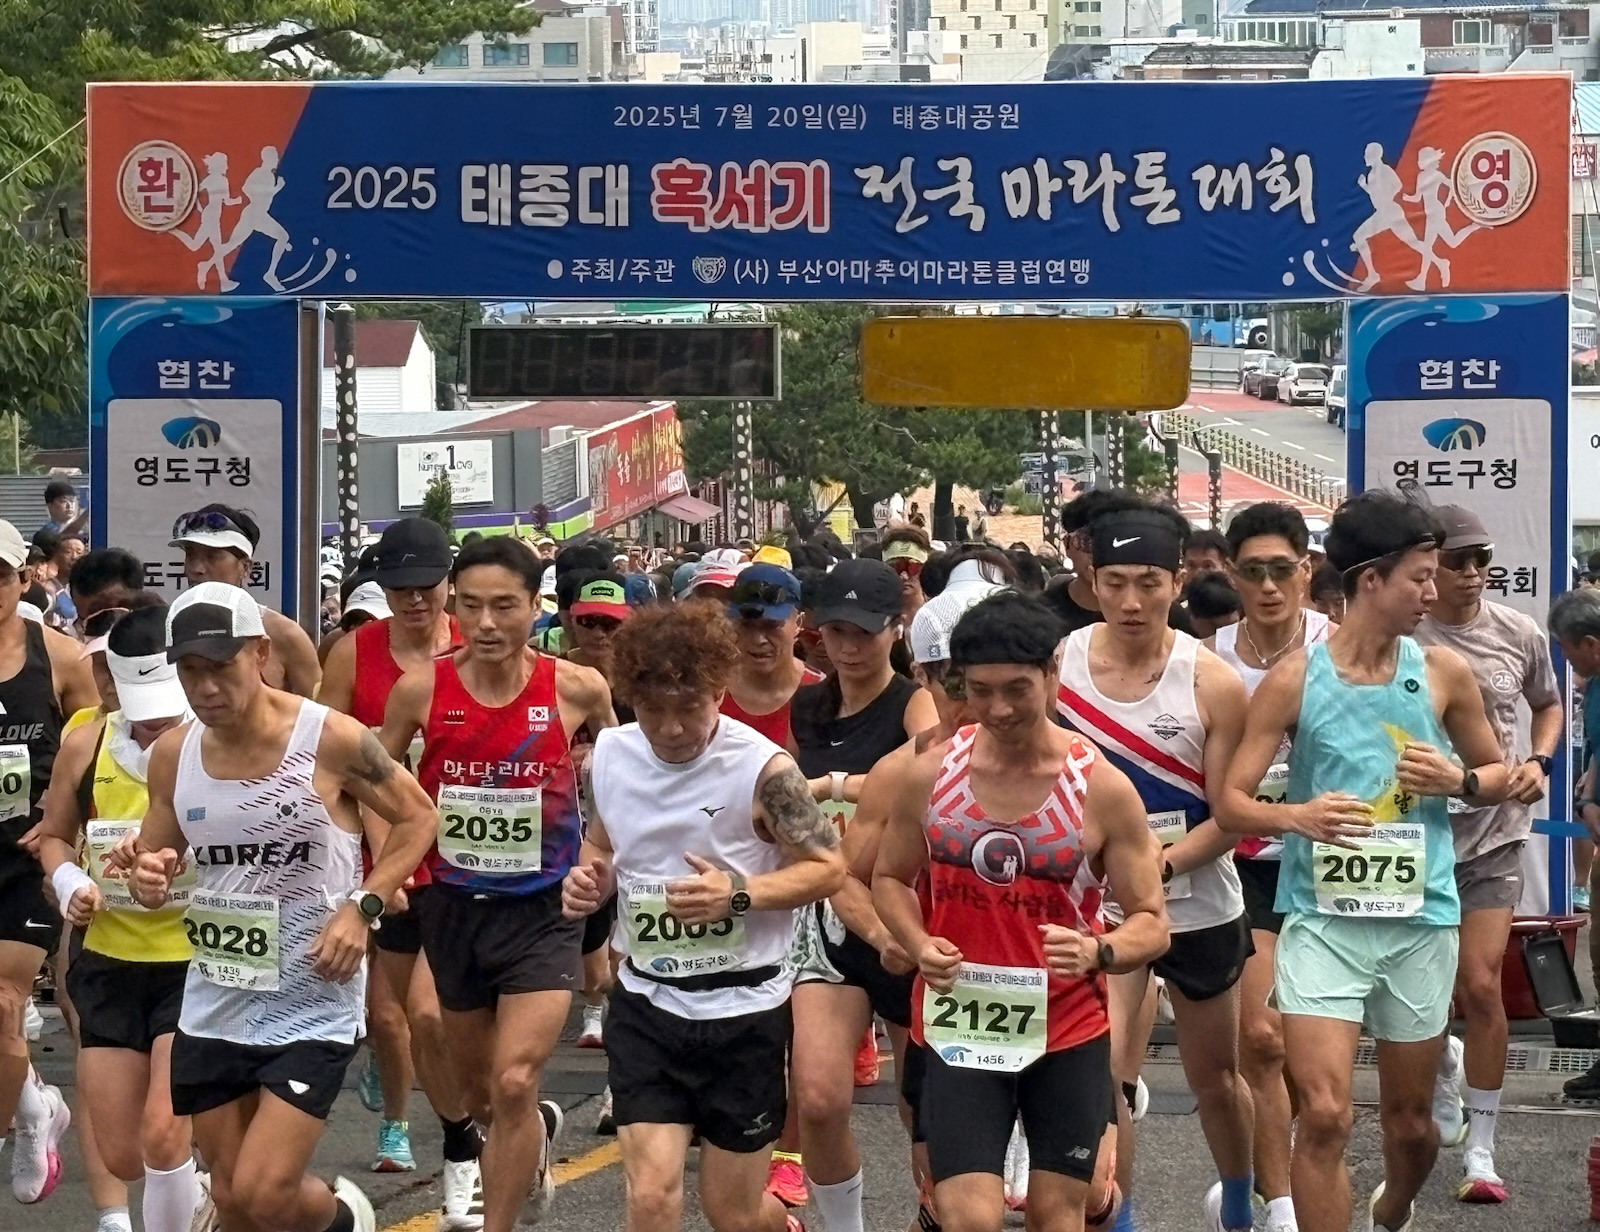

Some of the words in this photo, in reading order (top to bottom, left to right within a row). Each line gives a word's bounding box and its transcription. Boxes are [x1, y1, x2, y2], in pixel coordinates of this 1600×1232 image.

[613, 102, 700, 129] 2025년
[714, 103, 753, 130] 7월
[766, 103, 867, 131] 20일(일)
[893, 103, 1020, 130] 태종대공원
[137, 157, 181, 213] 환
[326, 165, 438, 210] 2025
[459, 163, 629, 227] 태종대
[650, 158, 832, 234] 혹서기
[855, 156, 988, 233] 전국
[1001, 152, 1181, 233] 마라톤
[1191, 147, 1316, 224] 대회
[1471, 149, 1511, 209] 영
[570, 258, 676, 284] 주최/주관
[733, 258, 769, 285] (사)
[777, 258, 1091, 285] 부산아마추어마라톤클럽연맹
[157, 359, 236, 390] 협찬
[1419, 359, 1502, 390] 협찬
[134, 456, 251, 487] 영도구청
[1393, 458, 1518, 490] 영도구청
[445, 814, 532, 843] 2035
[1322, 854, 1416, 884] 2075
[183, 917, 268, 957] 2028
[931, 996, 1036, 1035] 2127
